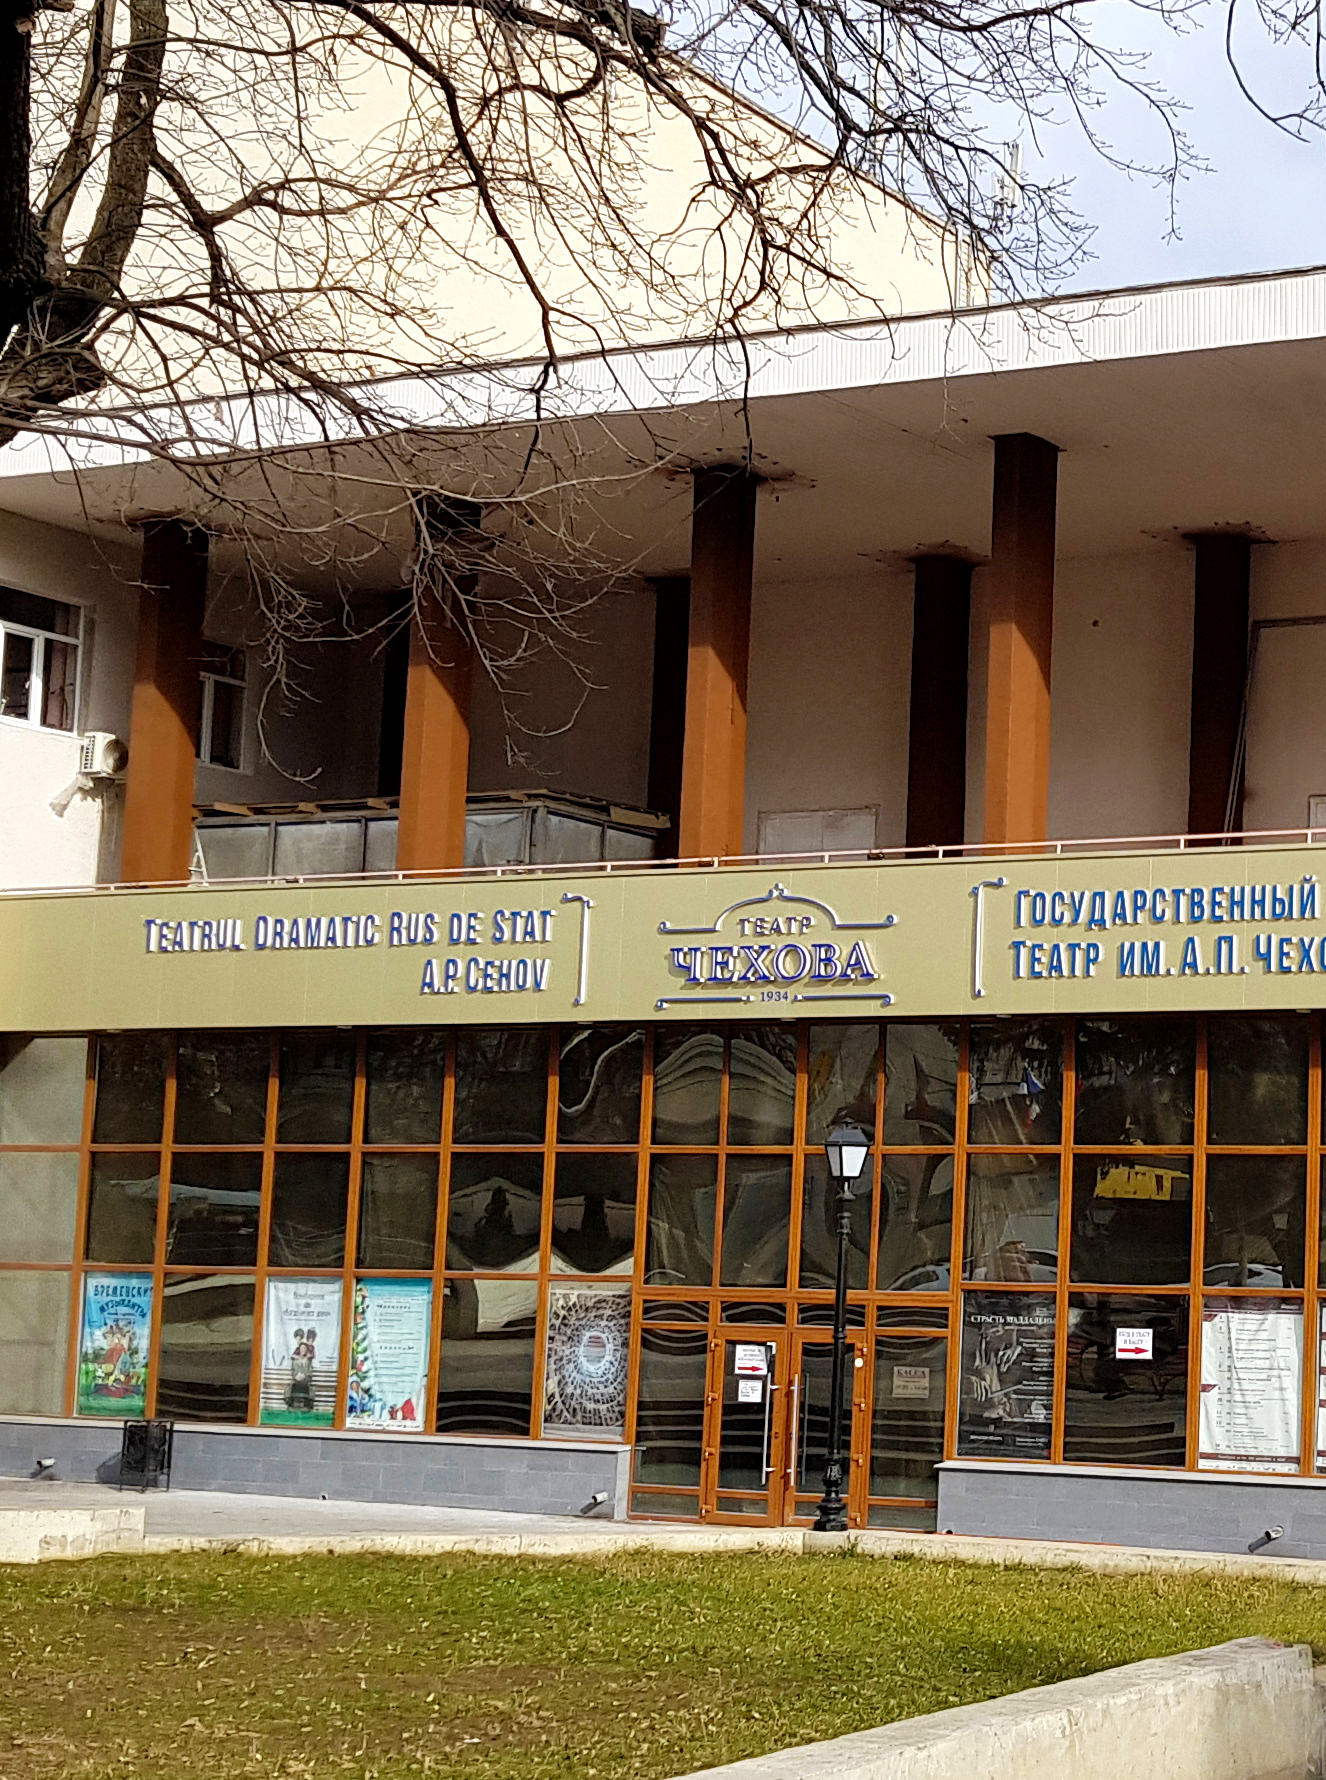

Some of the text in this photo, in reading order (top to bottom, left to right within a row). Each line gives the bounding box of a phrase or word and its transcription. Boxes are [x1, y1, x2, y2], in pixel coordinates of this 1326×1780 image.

[1014, 875, 1321, 930] ГОСУДАРСТВЕННЫЙ
[145, 909, 557, 952] TEATRUL DRAMATIC RUS DE STAT
[739, 915, 815, 937] ТЕАТР
[466, 956, 552, 992] CEHOV
[670, 940, 879, 984] ЧЕХОВА
[1010, 939, 1104, 978] ТЕАТР
[760, 991, 789, 1003] 1934
